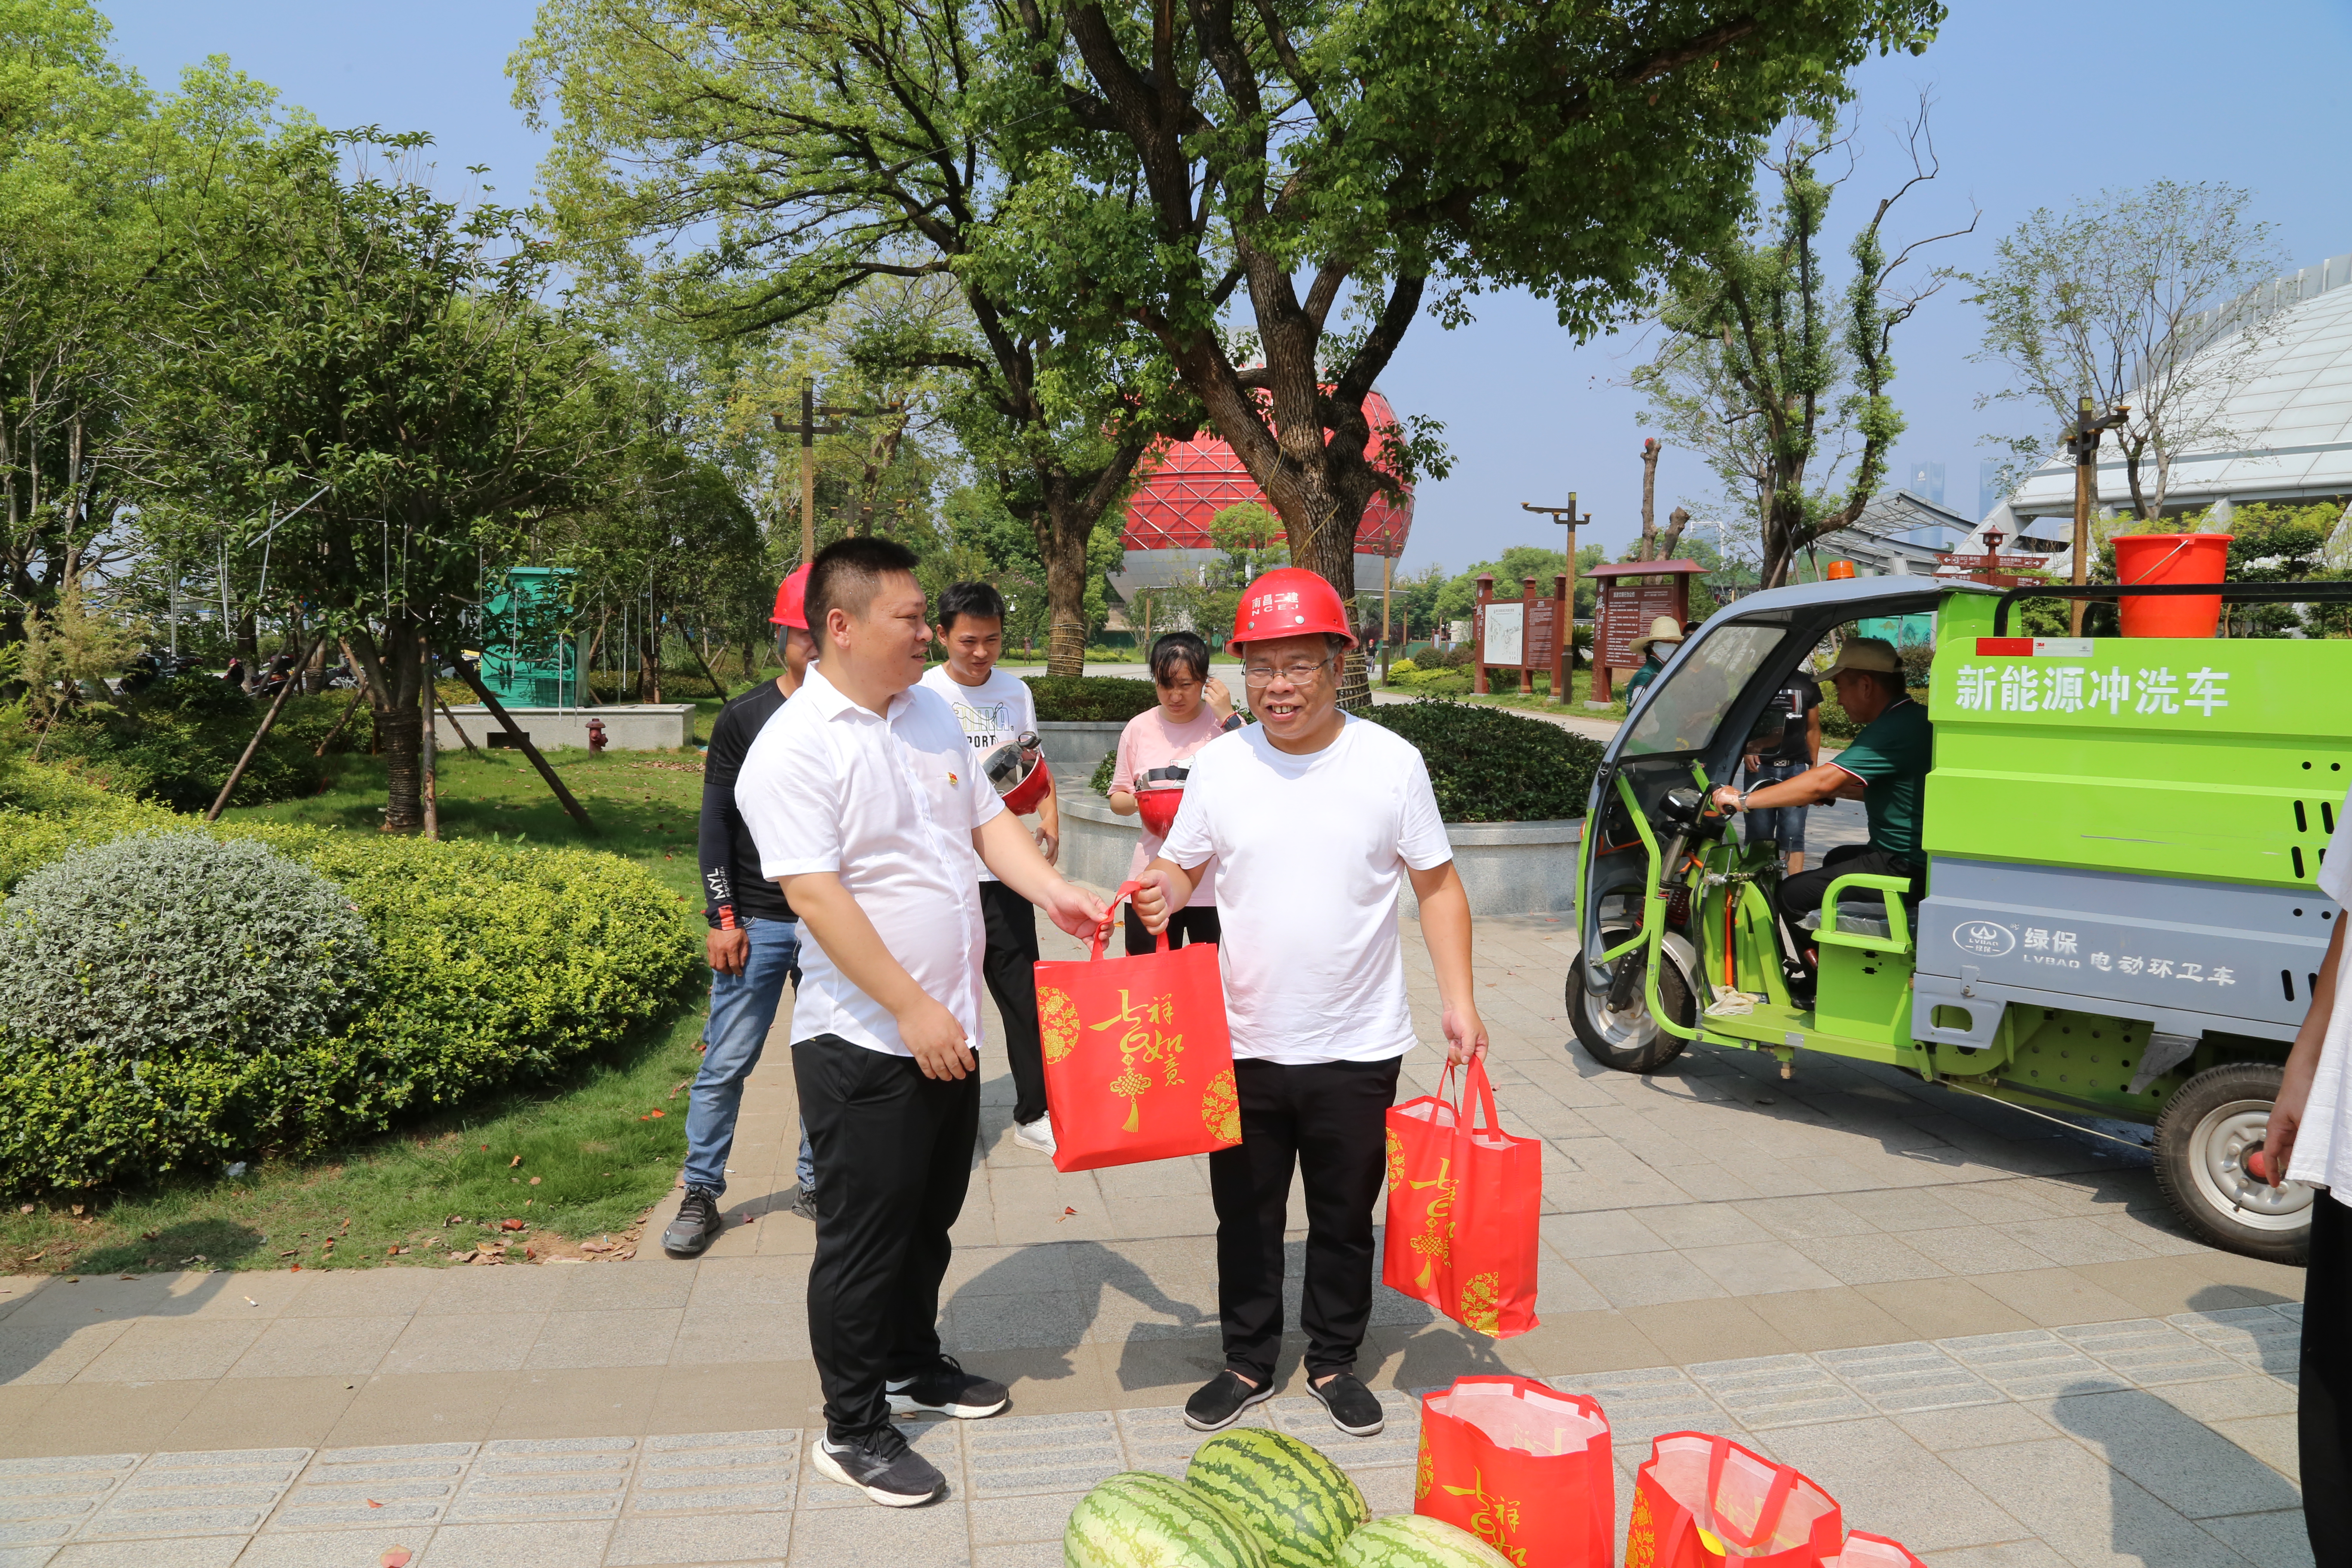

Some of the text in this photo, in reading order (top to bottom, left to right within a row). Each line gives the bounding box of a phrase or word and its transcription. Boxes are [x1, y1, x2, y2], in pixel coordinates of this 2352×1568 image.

[1252, 592, 1298, 609] 南昌二建
[1252, 604, 1298, 616] NCEJ
[1955, 665, 2229, 717] 新能源冲洗车
[1969, 938, 1998, 946] LVBAO
[2024, 927, 2079, 954] 绿保
[1975, 944, 1991, 953] 绿保
[2023, 954, 2080, 968] LVBAO
[2091, 952, 2236, 986] 电动环卫车
